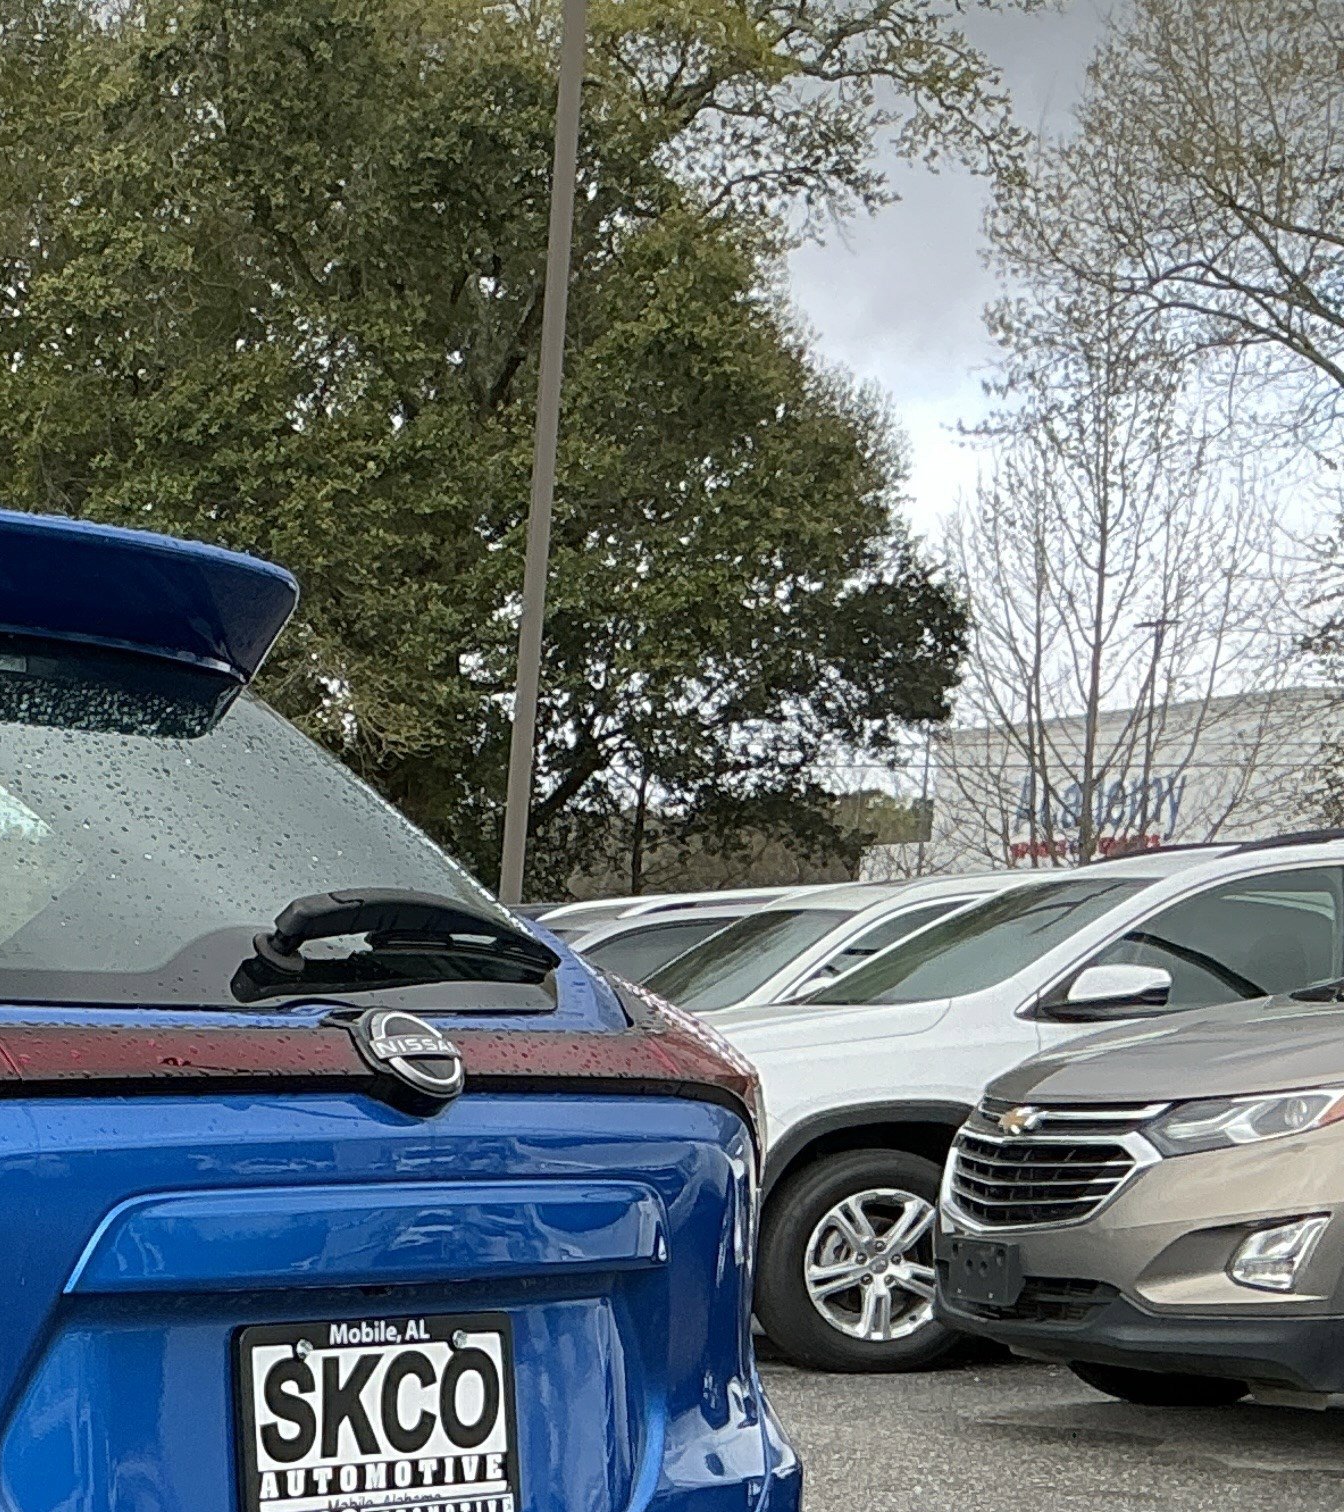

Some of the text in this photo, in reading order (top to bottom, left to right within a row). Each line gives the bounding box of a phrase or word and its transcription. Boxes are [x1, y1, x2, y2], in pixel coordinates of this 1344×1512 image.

[329, 1319, 431, 1345] Mobile, AL
[260, 1347, 500, 1463] SKCO
[260, 1453, 504, 1499] AUTOMOTIVE
